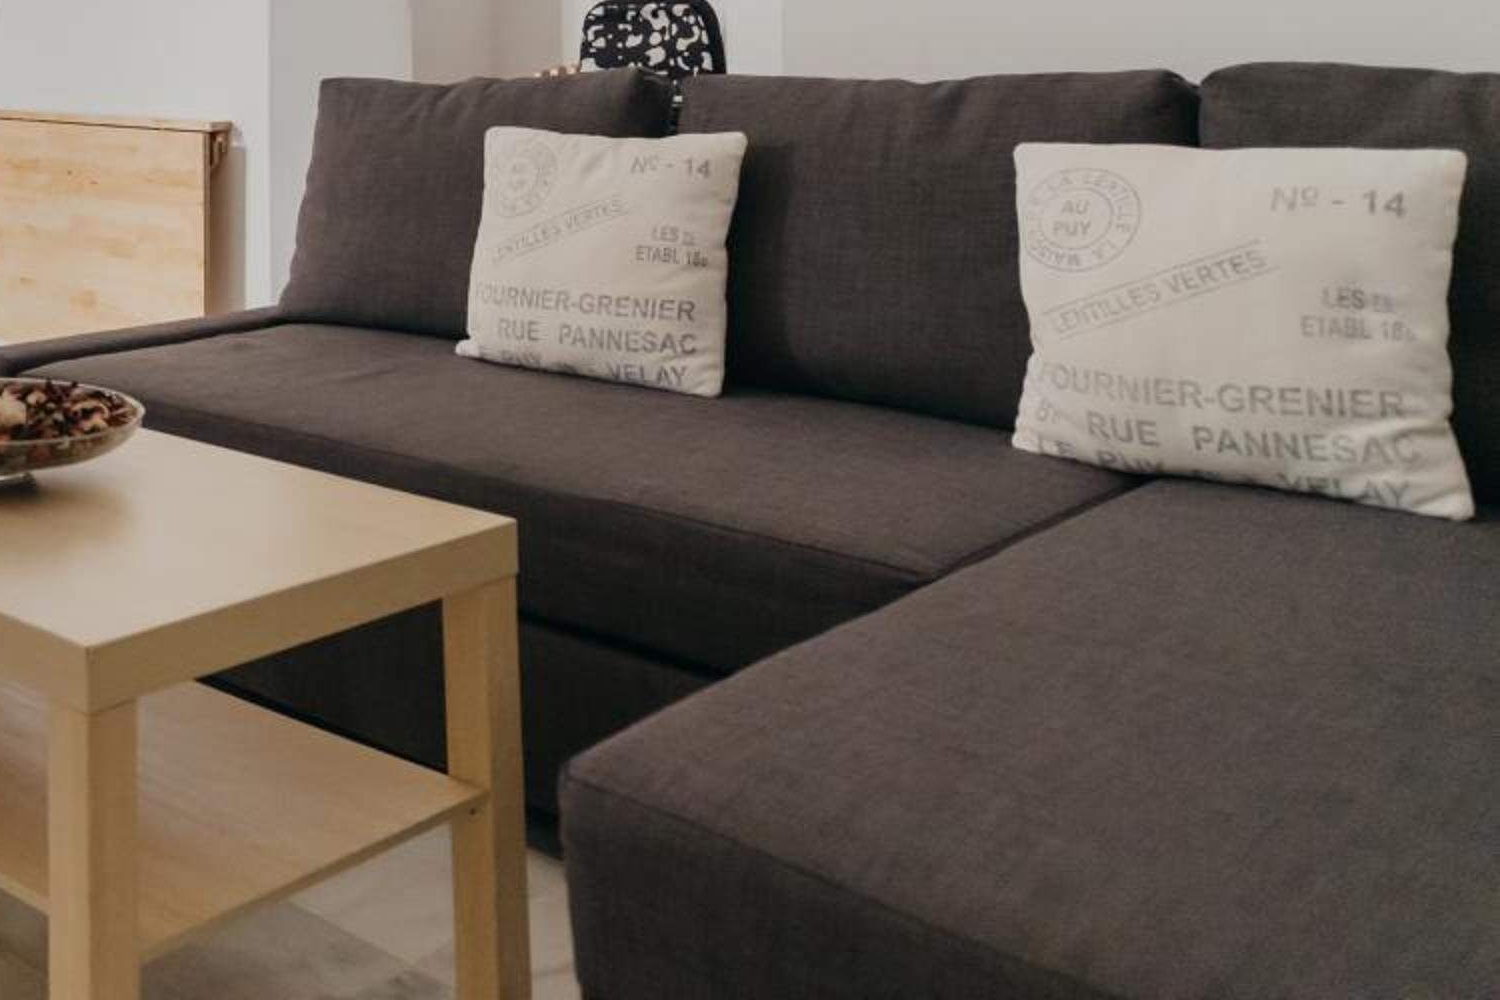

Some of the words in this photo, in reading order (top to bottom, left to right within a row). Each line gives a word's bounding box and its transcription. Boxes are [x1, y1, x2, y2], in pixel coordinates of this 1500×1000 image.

[683, 157, 710, 180] 14
[1061, 199, 1092, 216] AU
[1362, 188, 1408, 220] 14
[1052, 219, 1092, 237] PUY
[1166, 249, 1268, 302] VERTES
[1321, 285, 1366, 312] LES
[498, 317, 541, 343] RUE
[558, 323, 699, 356] PANNESAC
[1086, 410, 1160, 447] RUE
[1192, 424, 1421, 466] PANNESAC
